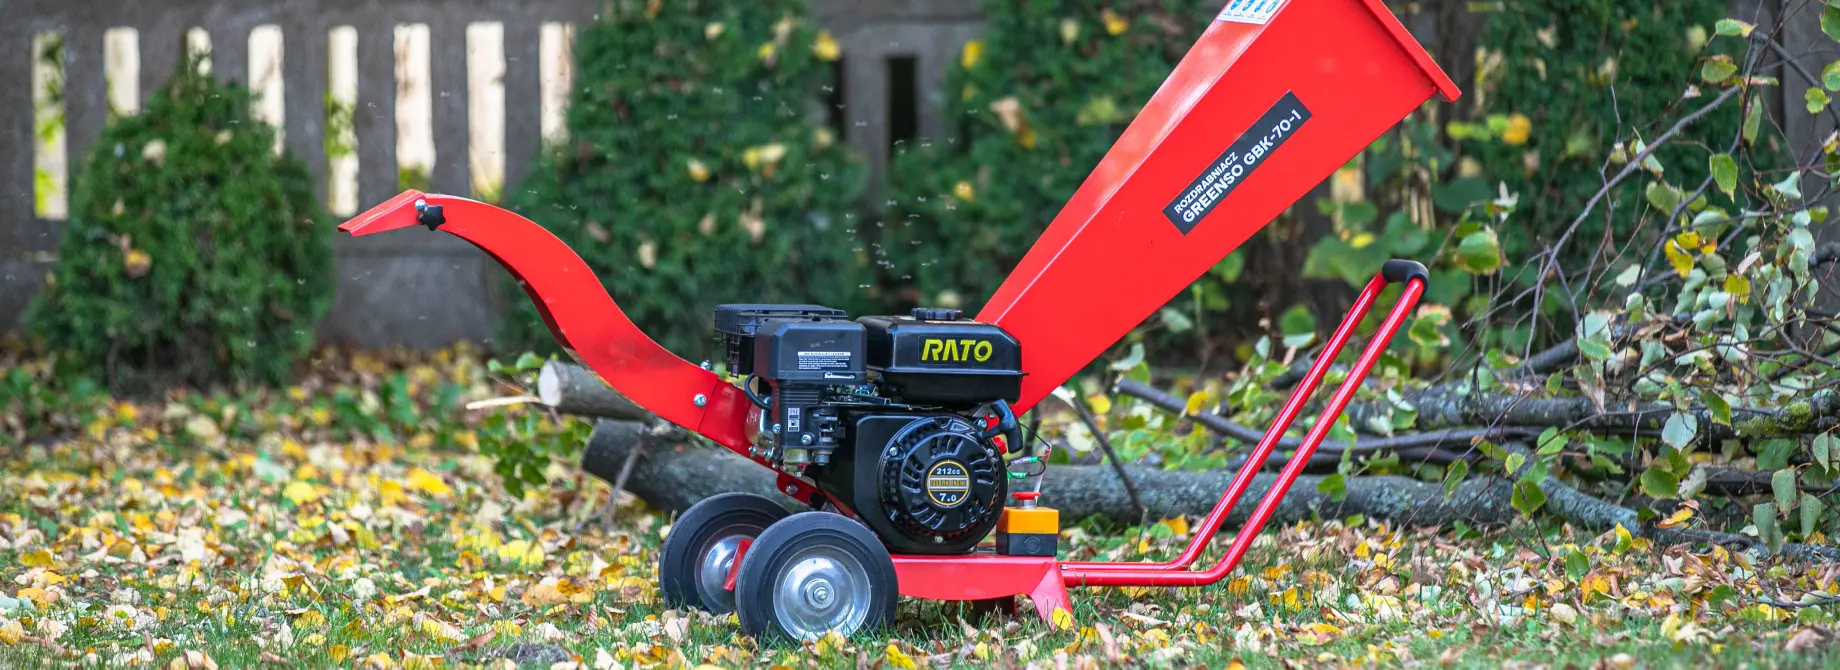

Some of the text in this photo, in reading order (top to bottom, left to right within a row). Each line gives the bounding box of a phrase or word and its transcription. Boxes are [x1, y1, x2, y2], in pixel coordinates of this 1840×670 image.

[1173, 151, 1239, 214] ROZDRABNIACZ
[1182, 109, 1302, 223] GREENSO GBK-70-1
[921, 338, 993, 362] RATO
[939, 493, 957, 502] 7.0
